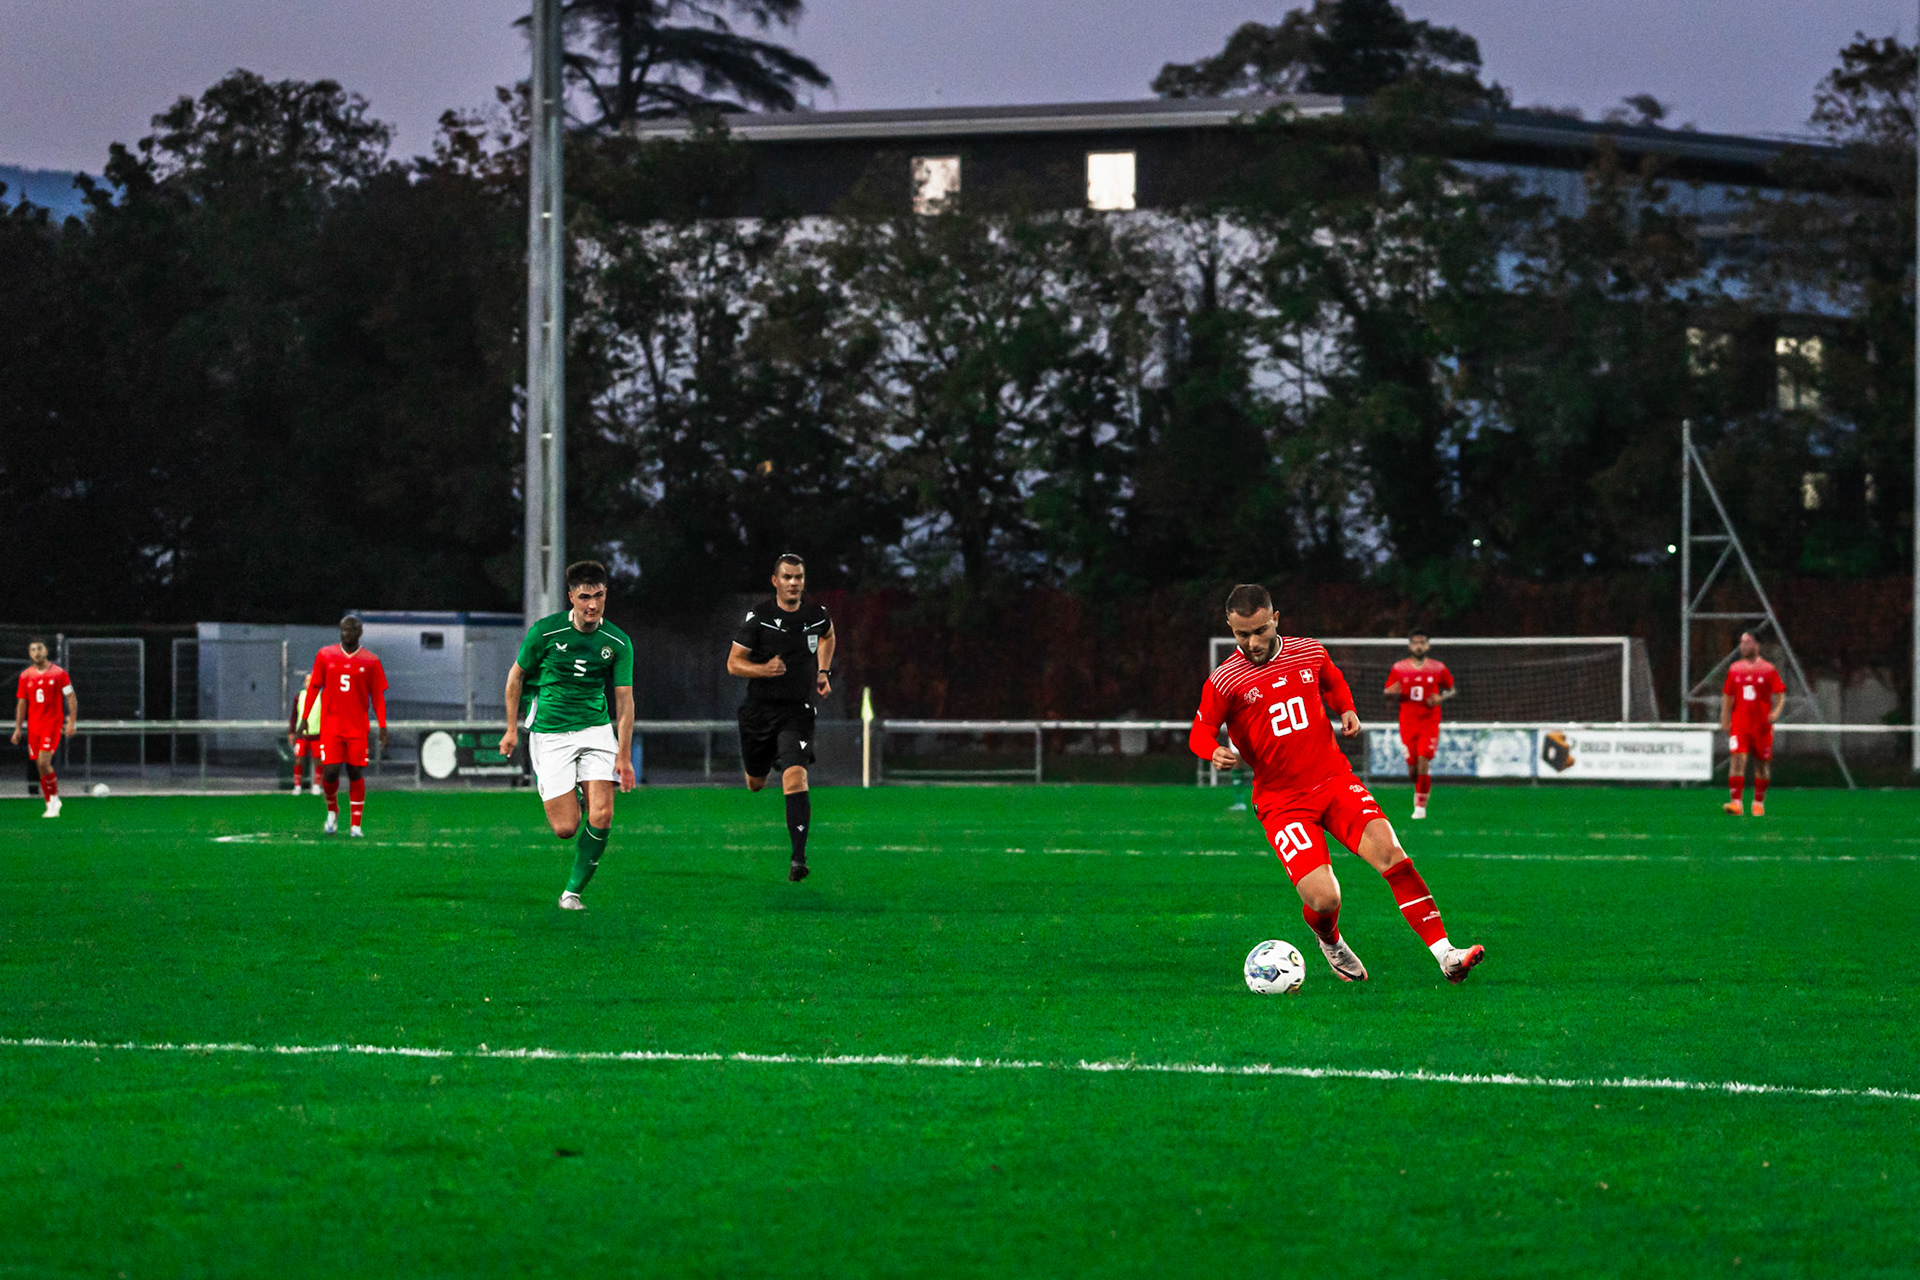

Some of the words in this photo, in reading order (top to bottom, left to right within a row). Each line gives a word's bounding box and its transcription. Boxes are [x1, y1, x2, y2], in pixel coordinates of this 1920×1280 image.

[573, 659, 587, 677] 5
[340, 674, 350, 692] 5
[36, 688, 45, 703] 6
[1268, 696, 1309, 737] 20
[1274, 821, 1313, 863] 20
